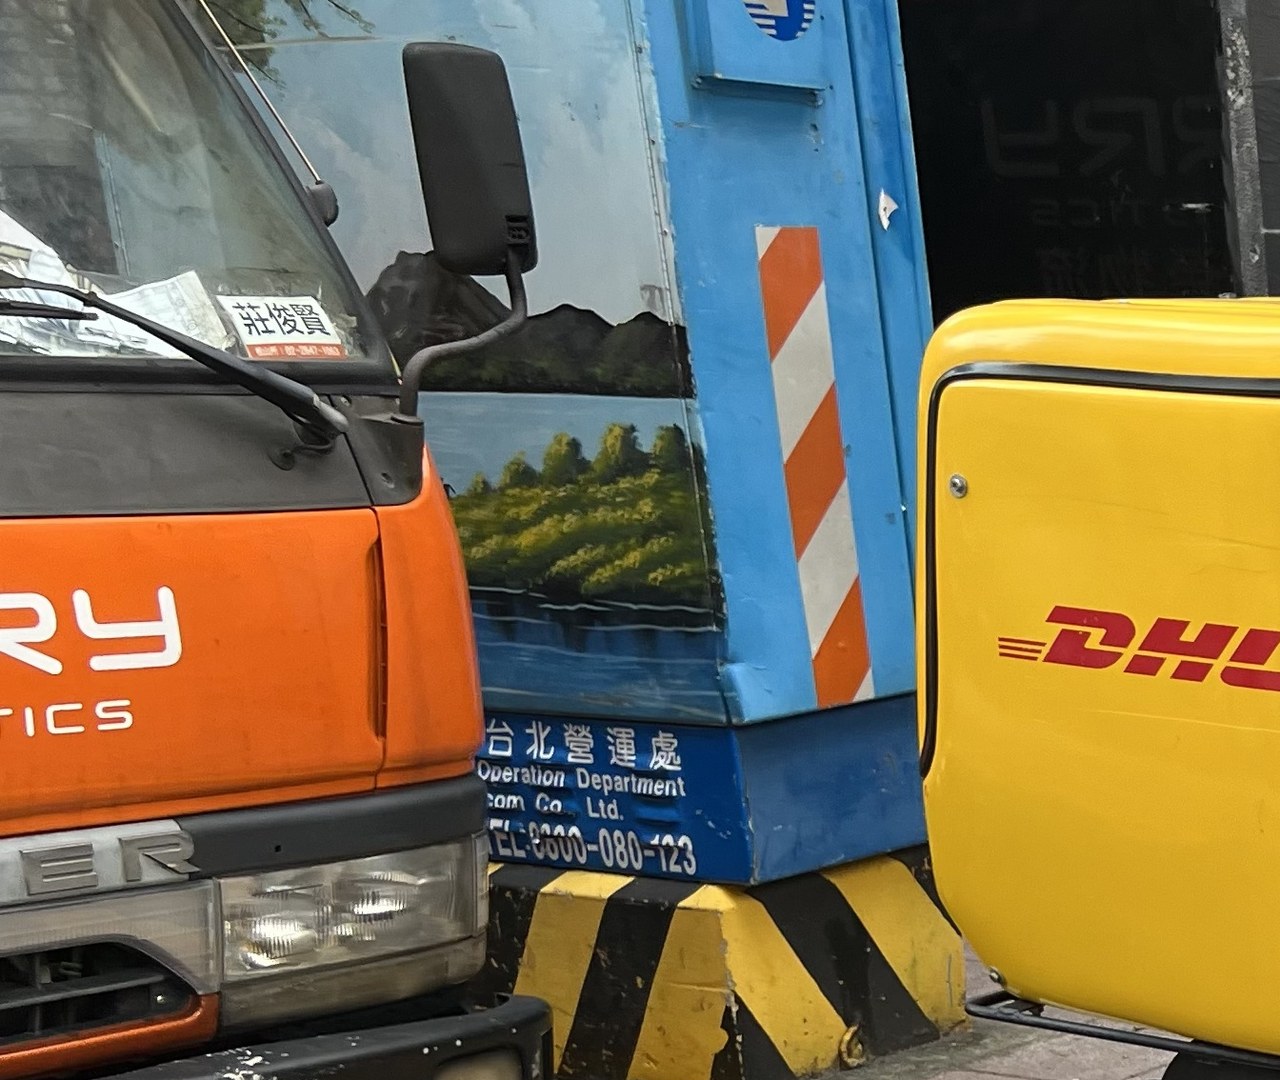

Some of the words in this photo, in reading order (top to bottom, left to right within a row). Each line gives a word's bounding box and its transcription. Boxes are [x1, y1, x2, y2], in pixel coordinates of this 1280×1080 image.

[232, 302, 331, 336] 莊俊賢
[487, 718, 683, 772] 台北營運處
[477, 759, 566, 788] Operation
[577, 768, 687, 798] Department
[586, 796, 624, 821] Ltd.
[19, 830, 201, 896] ER
